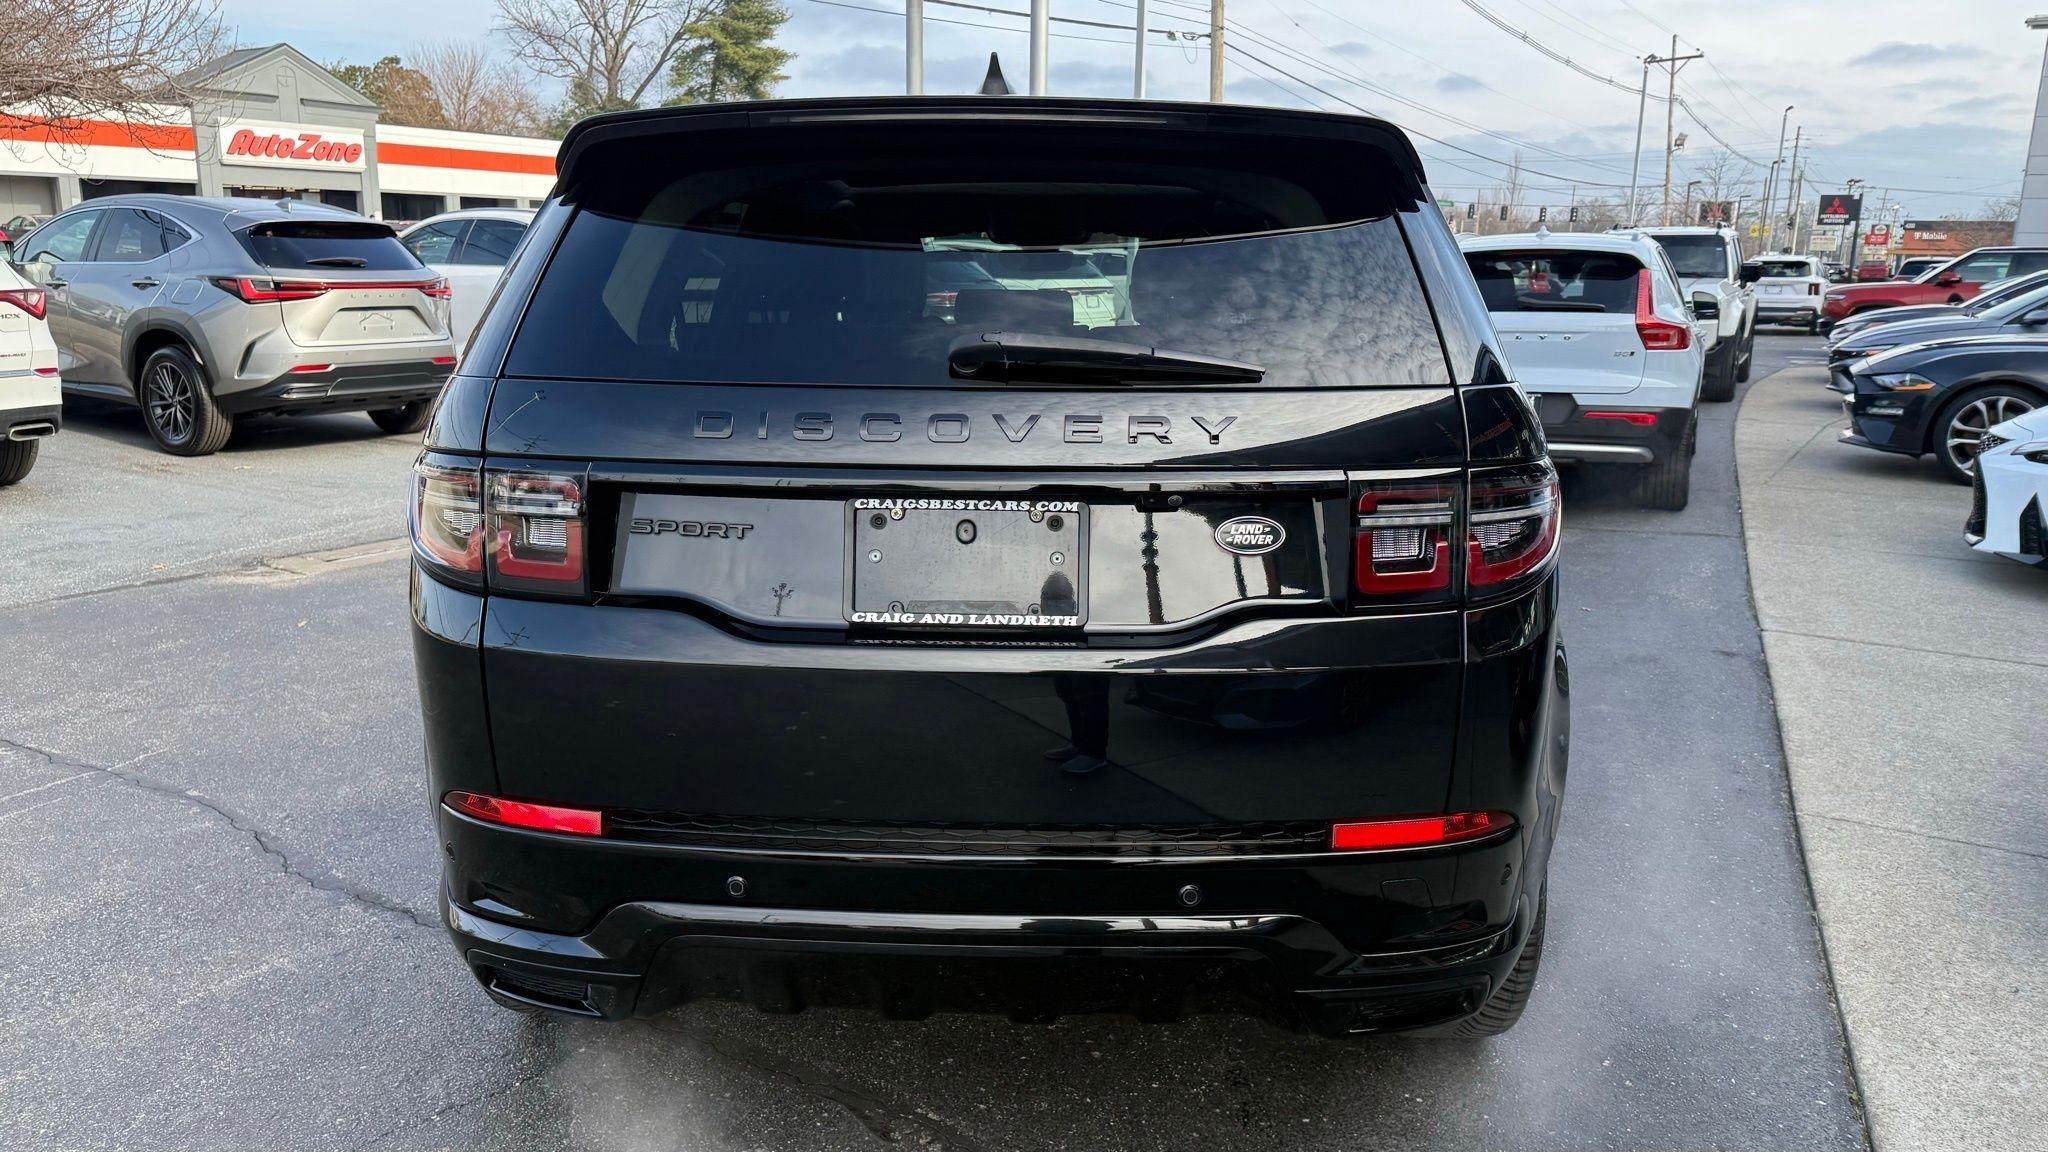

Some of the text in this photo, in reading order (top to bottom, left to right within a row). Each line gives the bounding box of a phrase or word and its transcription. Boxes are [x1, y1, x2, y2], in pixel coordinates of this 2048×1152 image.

[226, 129, 363, 163] AutoZone
[1922, 231, 1948, 240] Mobile
[693, 409, 1238, 444] DISCOVERY
[854, 498, 1079, 512] CRAIGSBESTCARS.COM
[630, 518, 753, 539] SPORT
[1230, 524, 1263, 534] LAND
[1233, 534, 1273, 545] ROVER
[851, 612, 1079, 626] CRAIG AND LANDRETH
